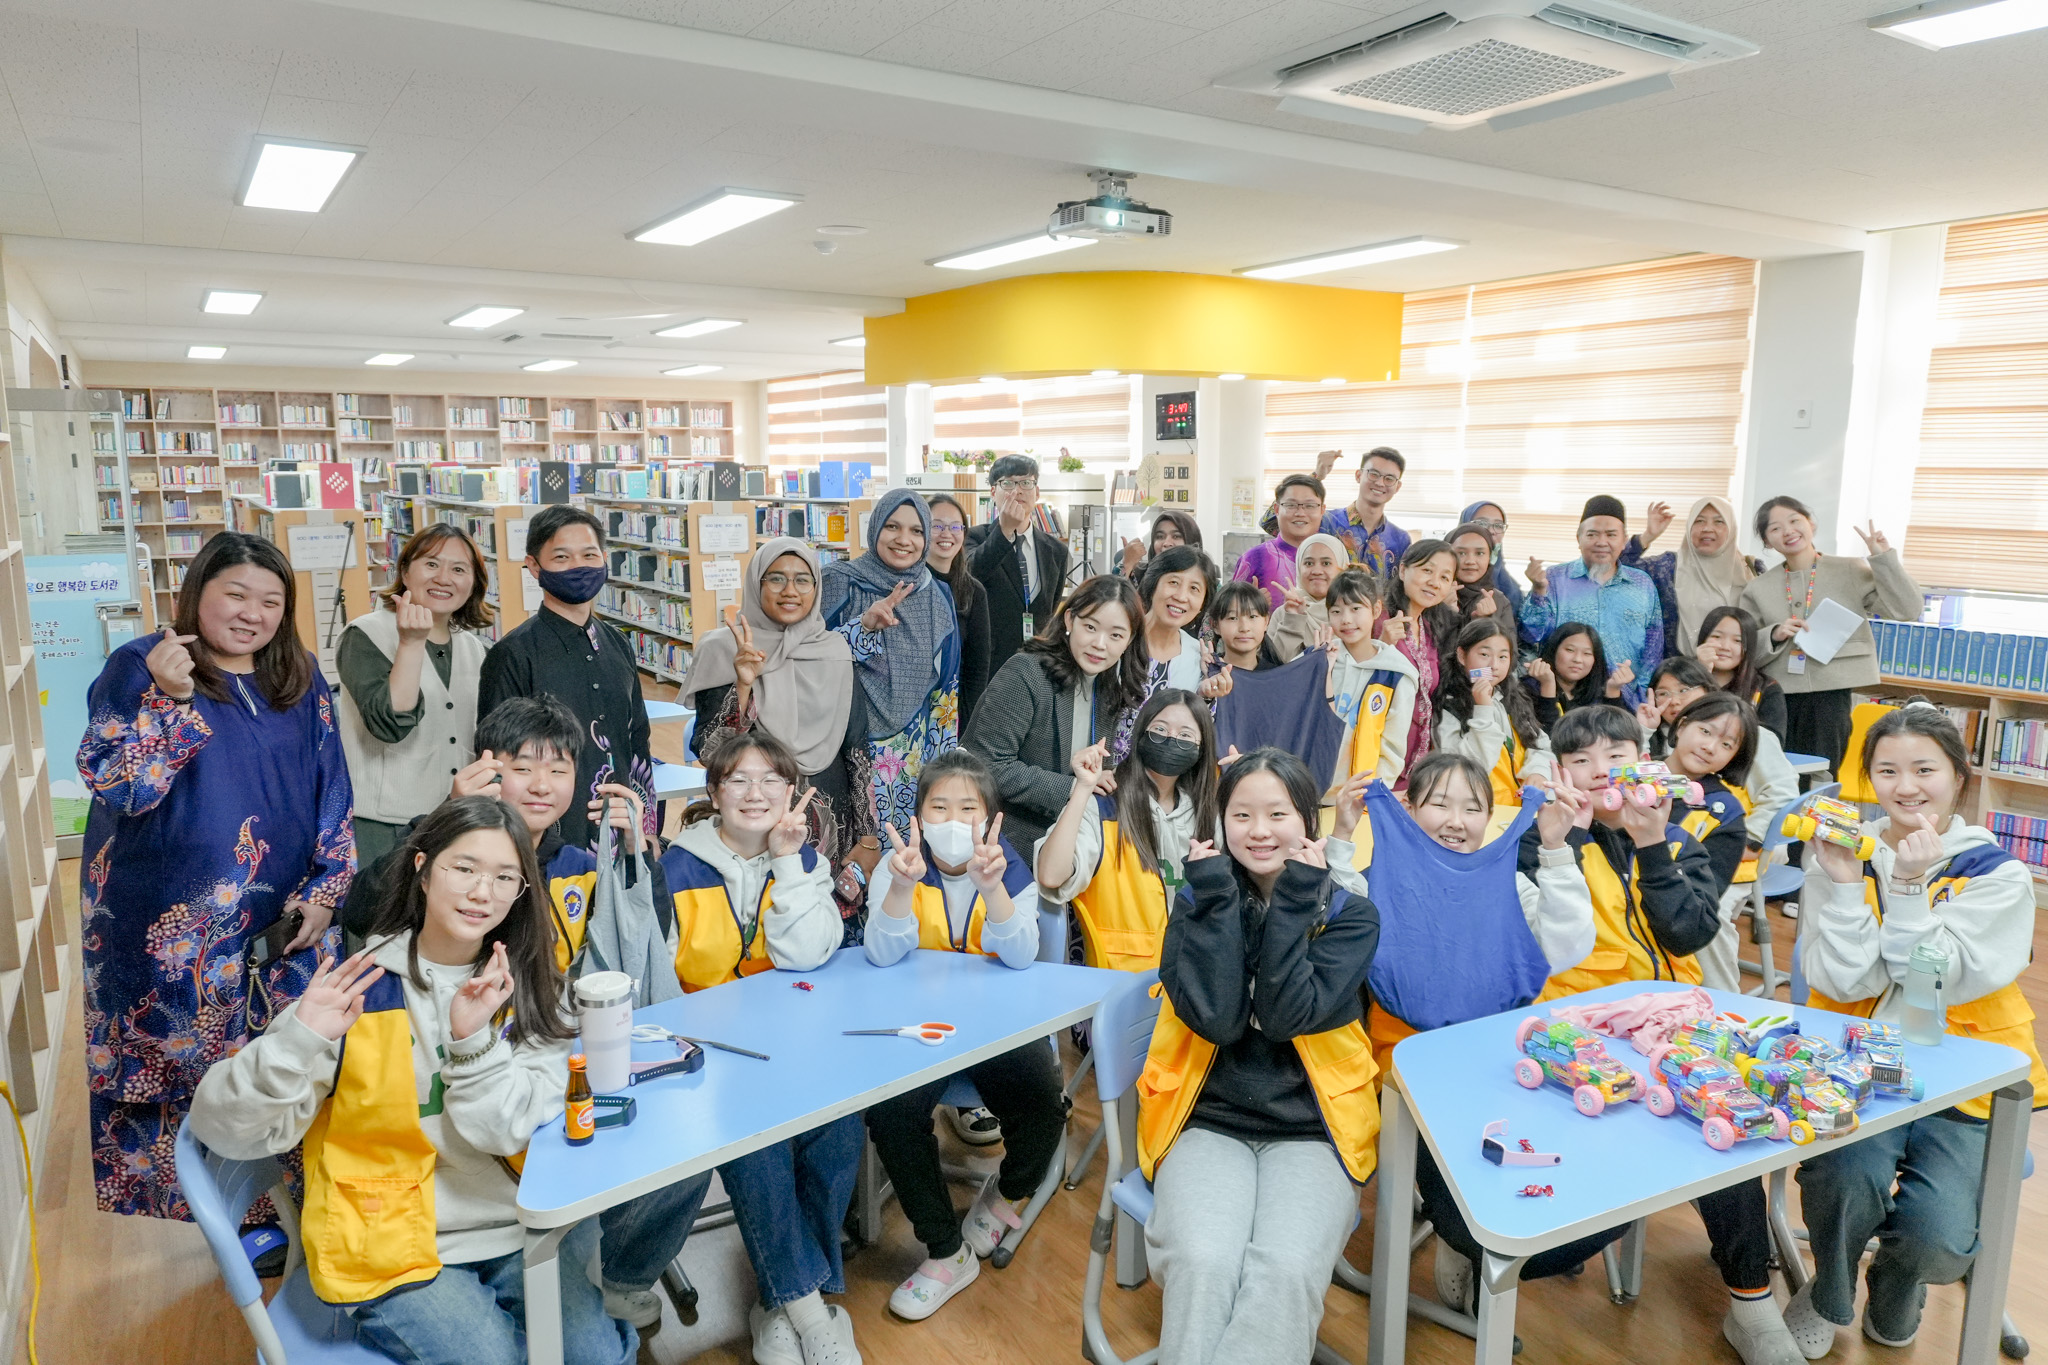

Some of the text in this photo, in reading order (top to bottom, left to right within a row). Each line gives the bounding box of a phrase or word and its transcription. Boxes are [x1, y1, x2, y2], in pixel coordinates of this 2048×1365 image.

[1168, 402, 1188, 415] 3:47
[905, 477, 922, 485] 신간도서
[57, 580, 87, 593] 행복한
[89, 579, 119, 591] 도서관
[45, 620, 60, 628] 것은
[34, 629, 55, 637] 시간을
